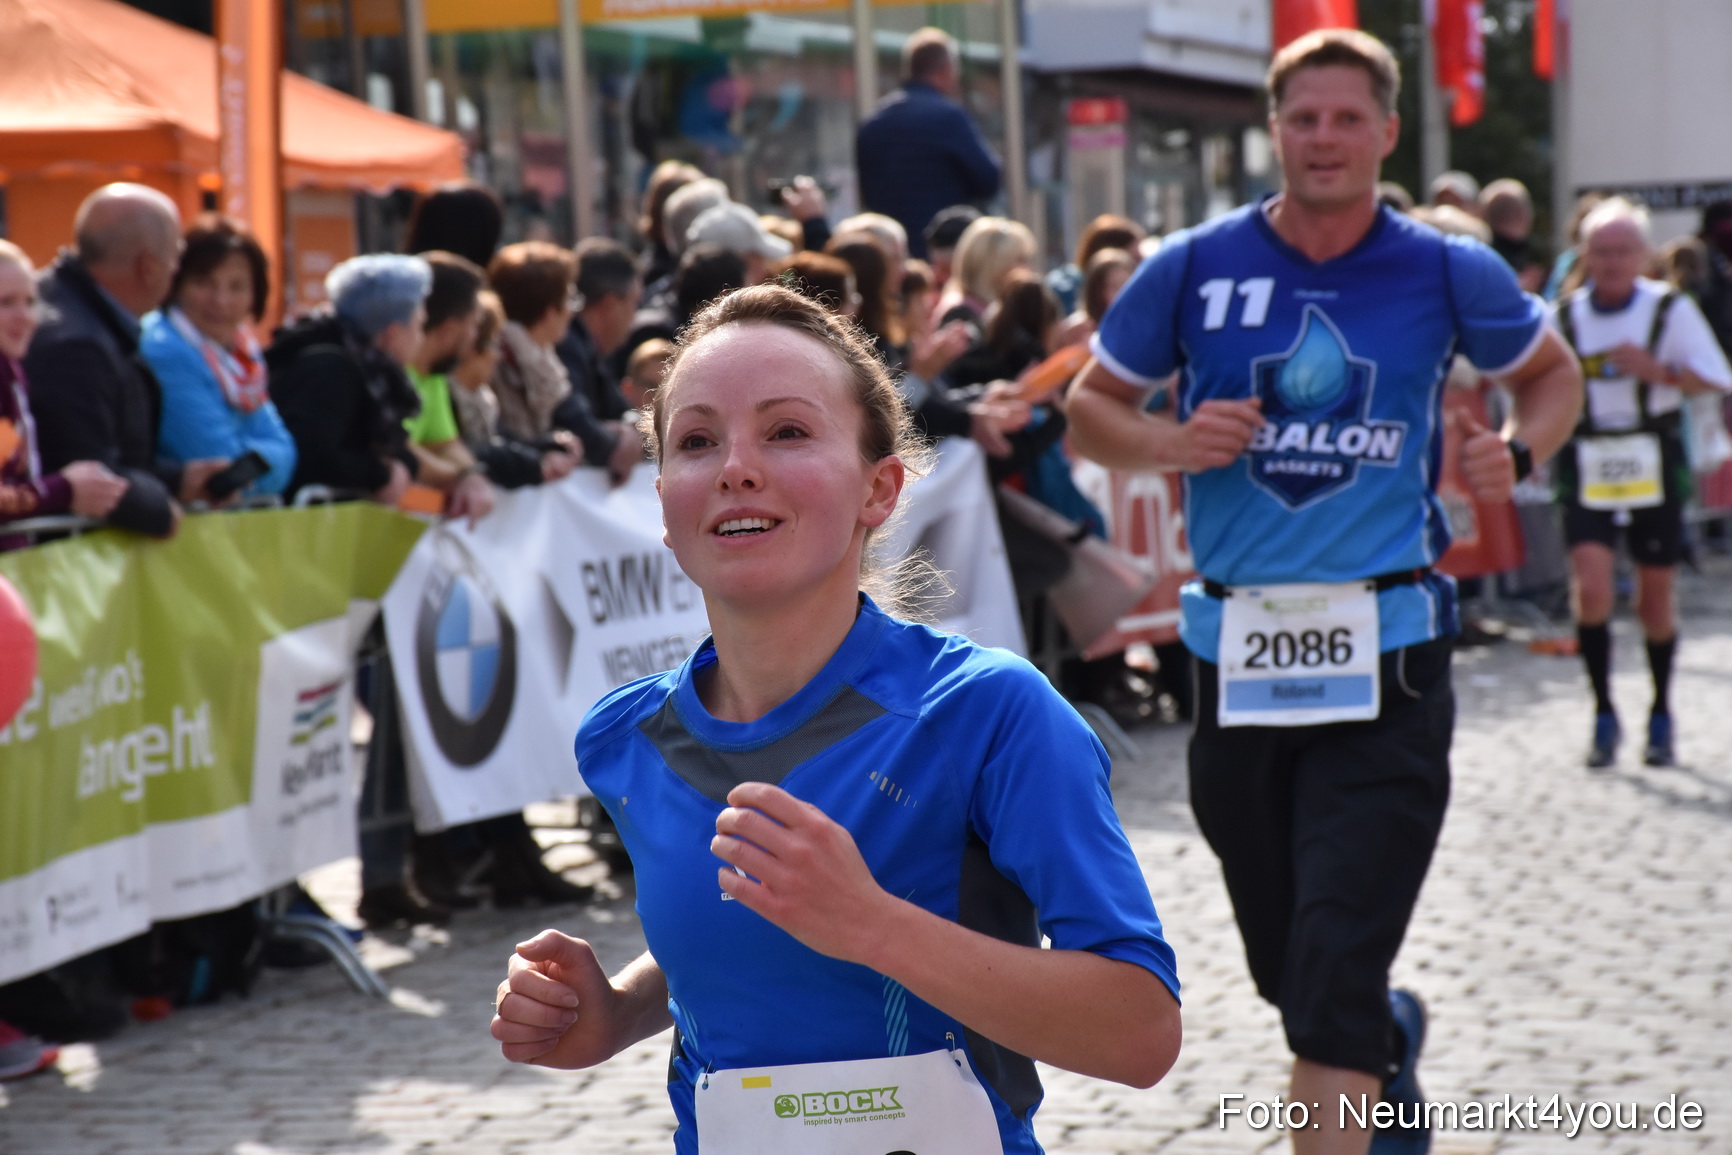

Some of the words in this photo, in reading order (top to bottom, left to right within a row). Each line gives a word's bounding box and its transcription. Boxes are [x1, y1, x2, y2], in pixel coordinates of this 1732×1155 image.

[1197, 276, 1276, 331] 11
[1263, 460, 1344, 478] BASKETS
[580, 552, 663, 625] BMW
[1243, 626, 1354, 670] 2086
[801, 1085, 904, 1117] BOCK
[803, 1117, 833, 1127] inspired
[834, 1116, 843, 1125] by
[844, 1115, 868, 1123] smart
[869, 1111, 906, 1122] concepts
